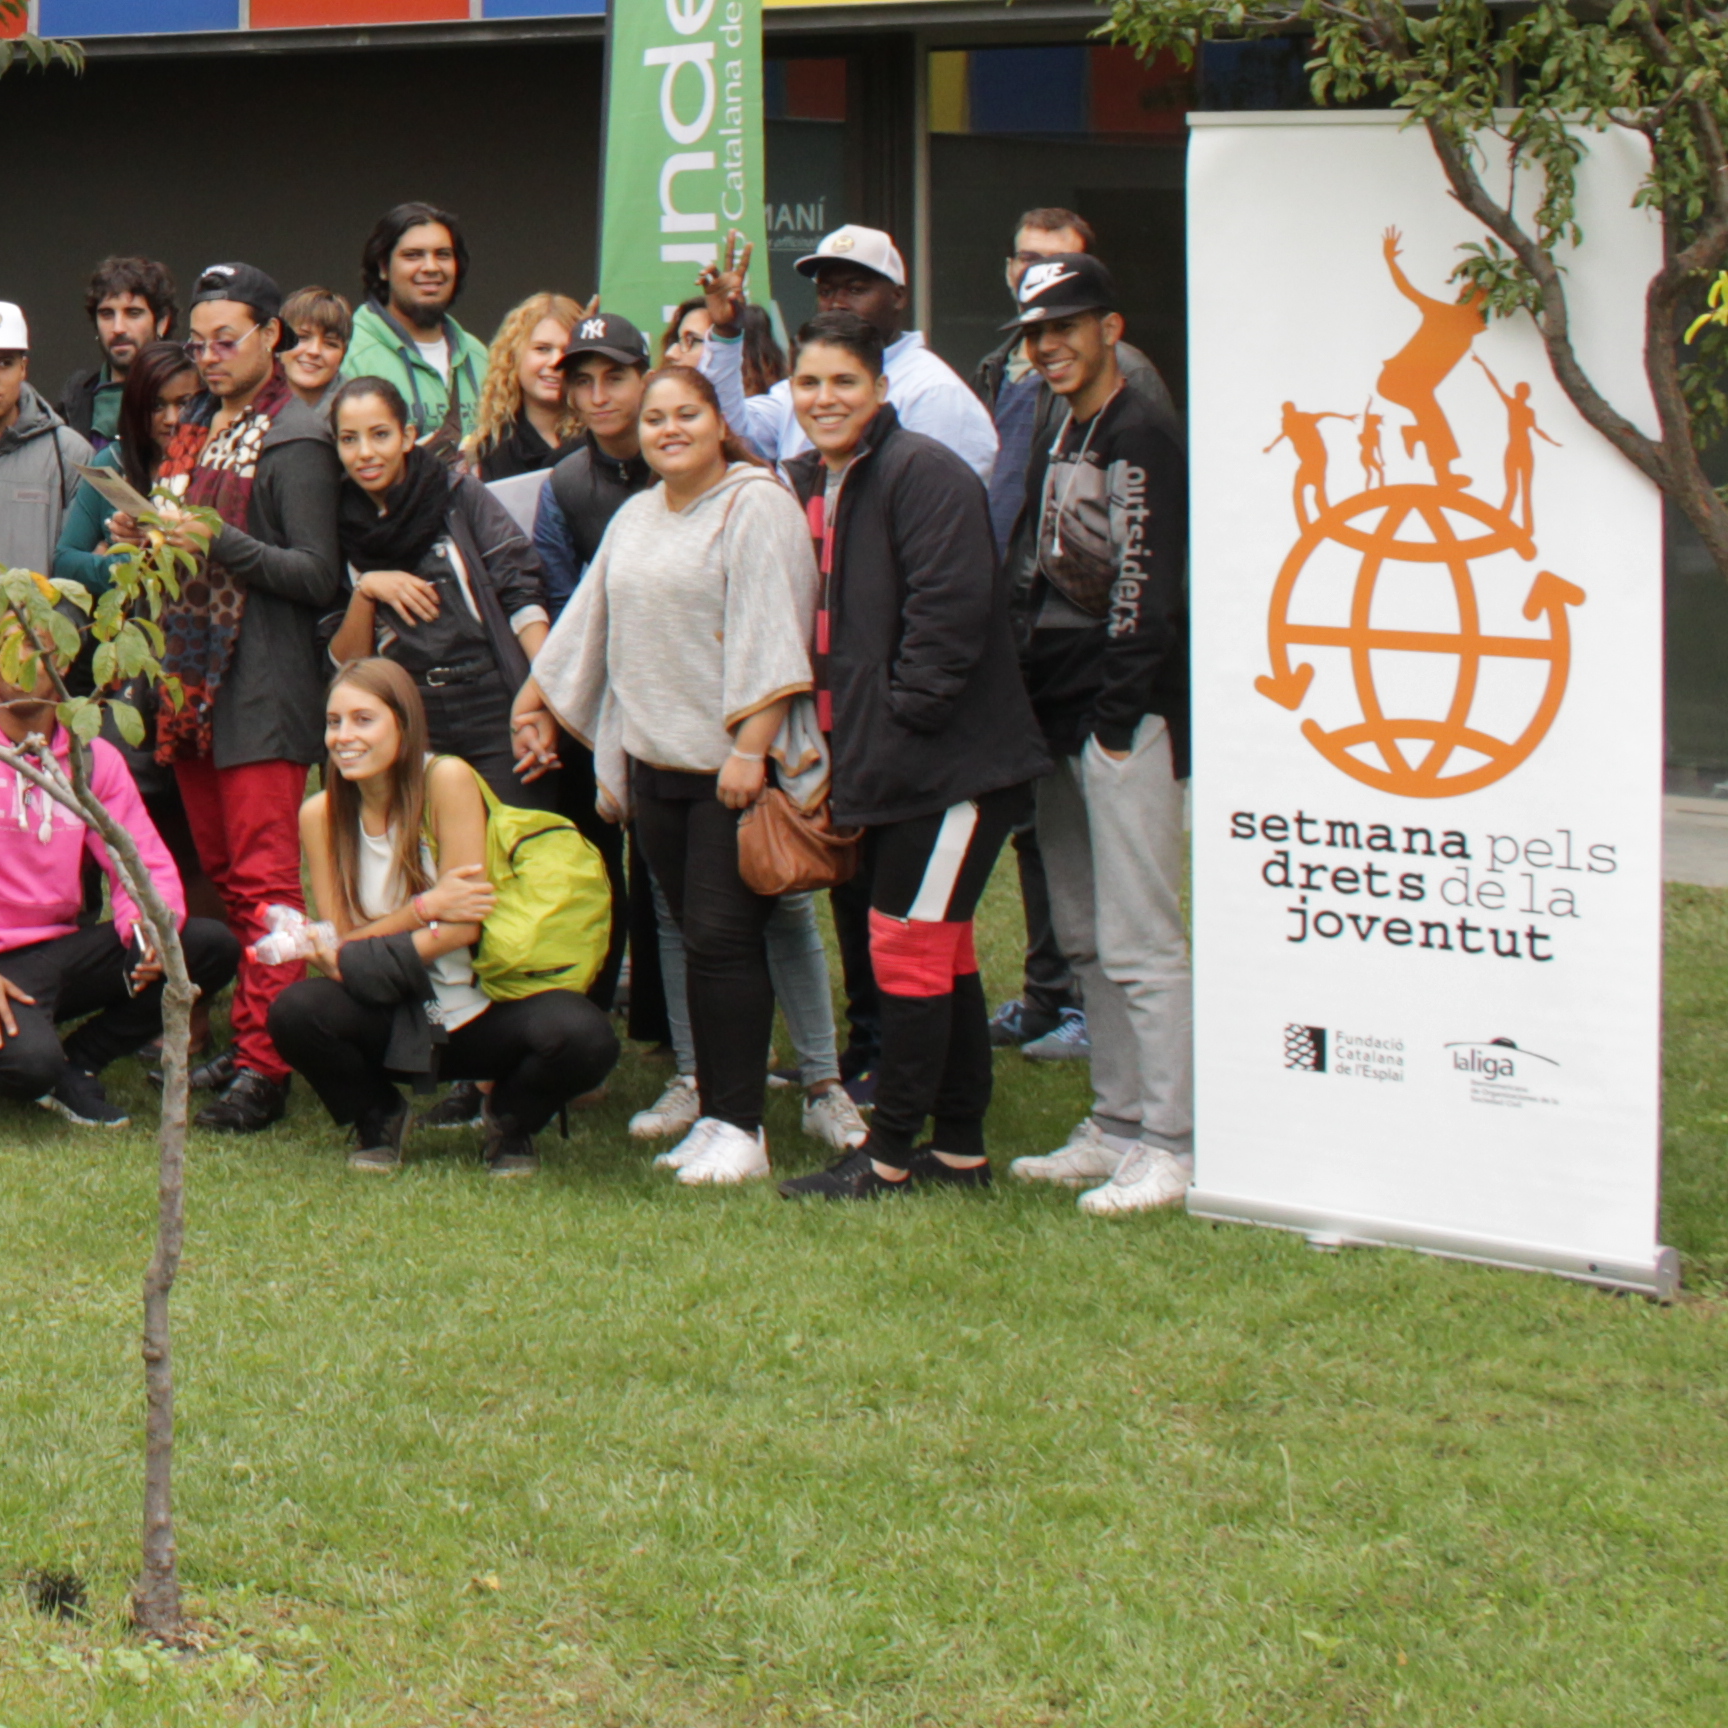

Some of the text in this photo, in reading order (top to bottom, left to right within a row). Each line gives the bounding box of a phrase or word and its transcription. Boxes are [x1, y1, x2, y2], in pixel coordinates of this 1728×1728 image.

[718, 1, 743, 49] de
[719, 59, 745, 220] Catalana
[1231, 810, 1618, 874] setmana pels
[1261, 850, 1582, 918] drets de la
[1286, 894, 1555, 963] joventut
[1335, 1030, 1405, 1051] Fundació
[1335, 1045, 1404, 1066] Catalana
[1452, 1048, 1514, 1080] laliga
[1335, 1062, 1404, 1083] de l'Esplai
